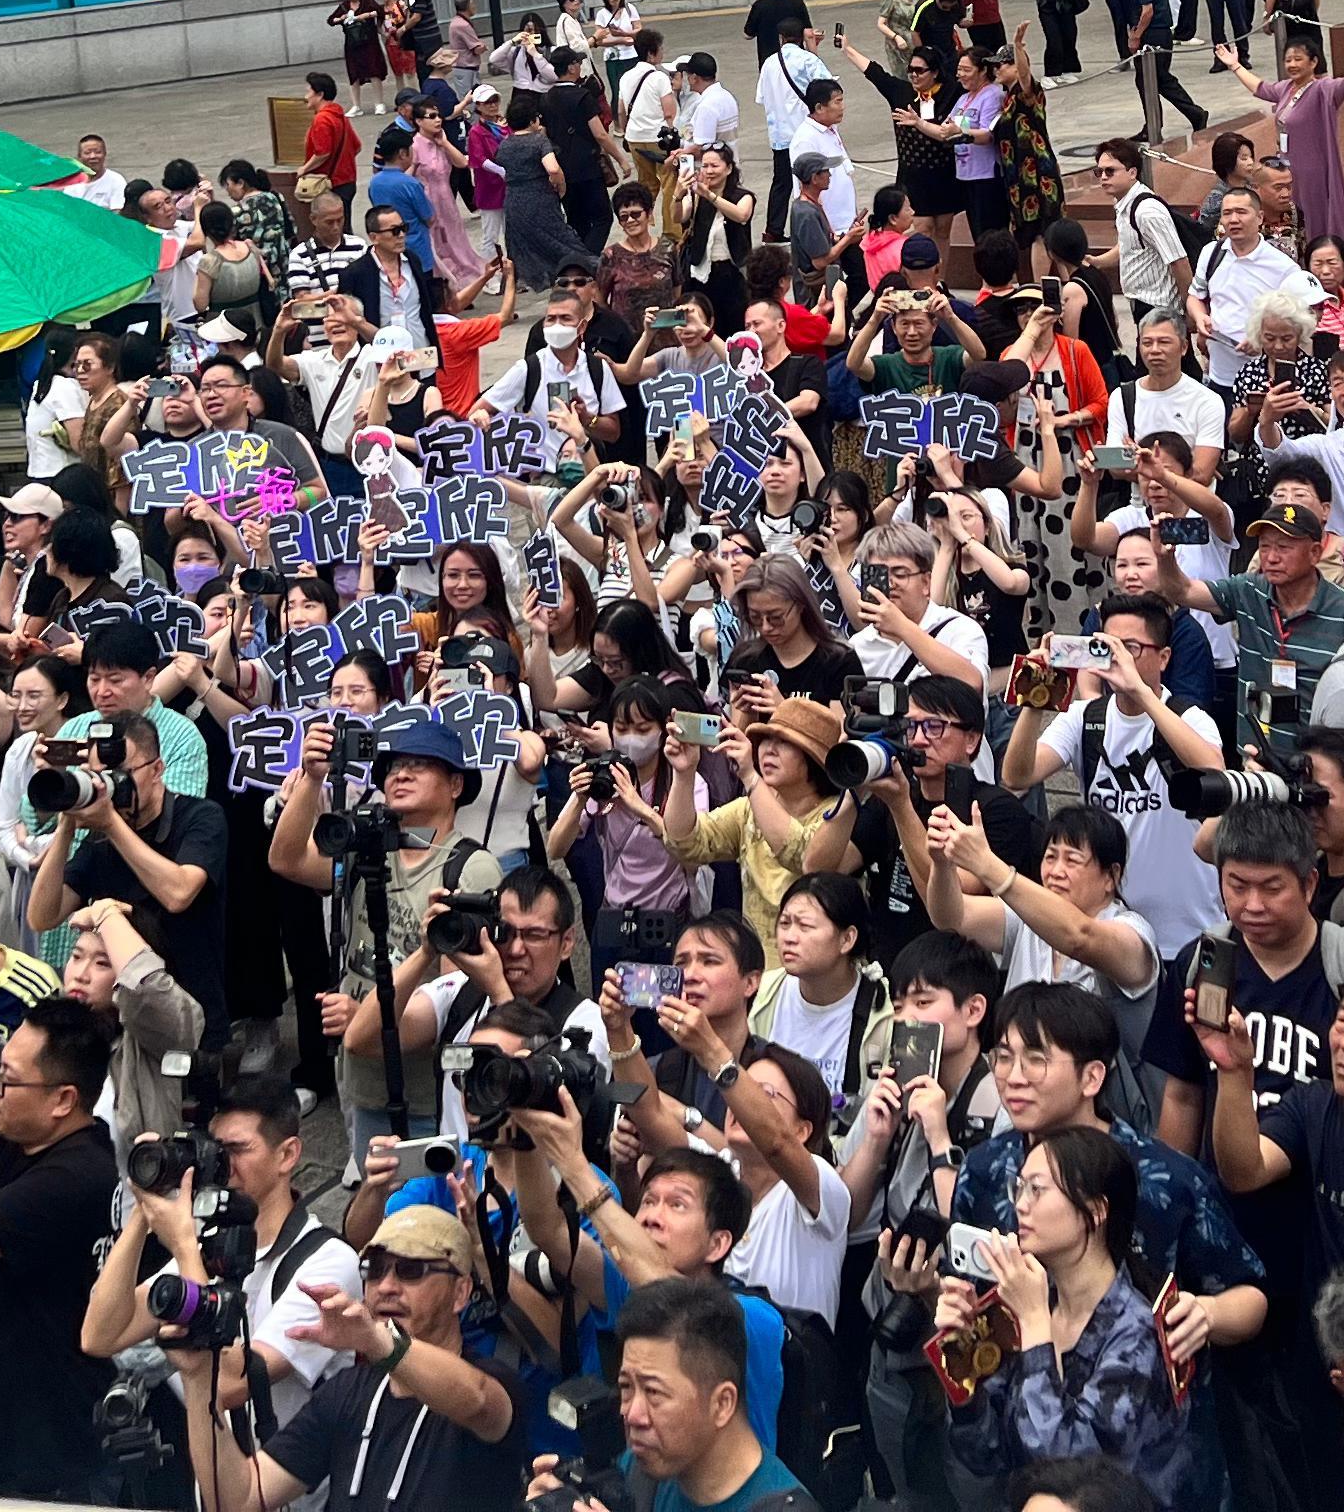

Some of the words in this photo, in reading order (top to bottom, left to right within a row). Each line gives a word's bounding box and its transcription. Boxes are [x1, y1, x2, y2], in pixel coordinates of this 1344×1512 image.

[415, 414, 546, 486] 定欣
[699, 394, 787, 530] 定欣
[859, 388, 999, 462] 定欣
[262, 595, 420, 710] 定欣
[1090, 787, 1162, 815] adidas
